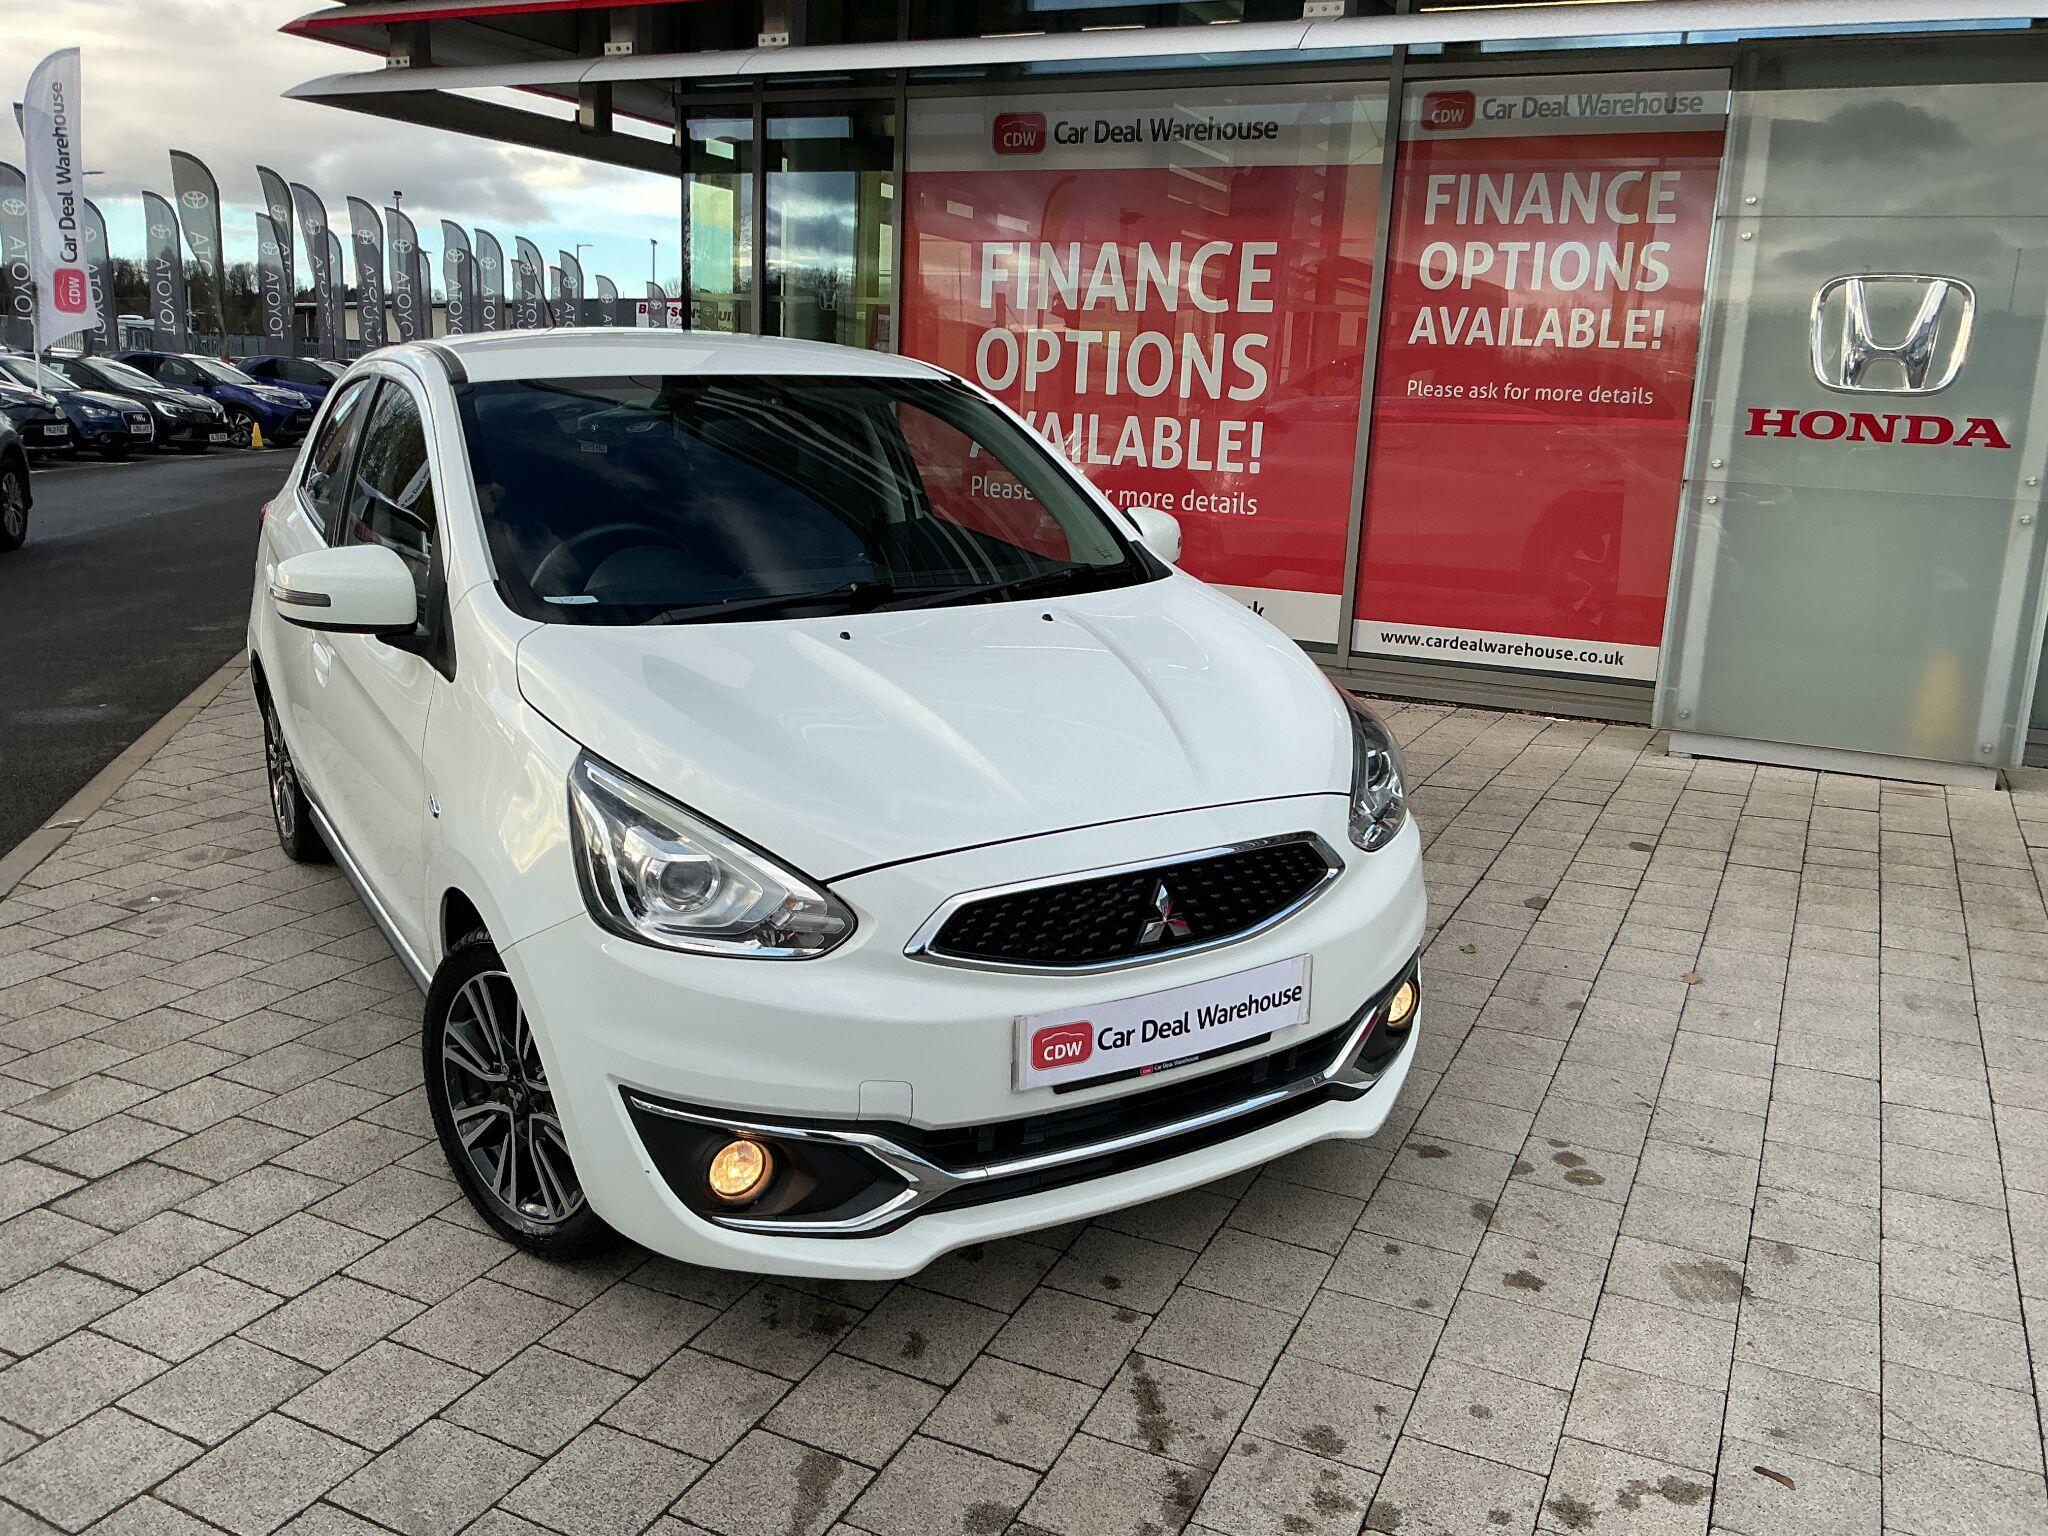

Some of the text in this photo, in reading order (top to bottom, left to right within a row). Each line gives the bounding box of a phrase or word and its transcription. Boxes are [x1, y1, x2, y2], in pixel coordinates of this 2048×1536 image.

[1430, 108, 1465, 124] CDW
[1481, 91, 1704, 121] Car Deal Warehouse
[1002, 131, 1037, 149] CDW
[1053, 115, 1279, 144] Car Deal Warehouse
[51, 81, 78, 263] Car Deal Warehouse
[1424, 170, 1682, 226] FINANCE
[979, 240, 1278, 314] FINANCE
[1418, 240, 1671, 293] OPTIONS
[69, 276, 81, 306] CDW
[1407, 305, 1664, 350] AVAILABLE!
[975, 328, 1270, 402] OPTIONS
[1406, 379, 1654, 406] Please ask for more details
[1744, 408, 2011, 450] HONDA
[1119, 489, 1175, 510] more
[1181, 489, 1258, 516] details
[1380, 631, 1625, 668] www.cardealwarehouse.co.uk
[1097, 983, 1303, 1052] Car Deal Warehouse
[1043, 1041, 1083, 1062] CDW
